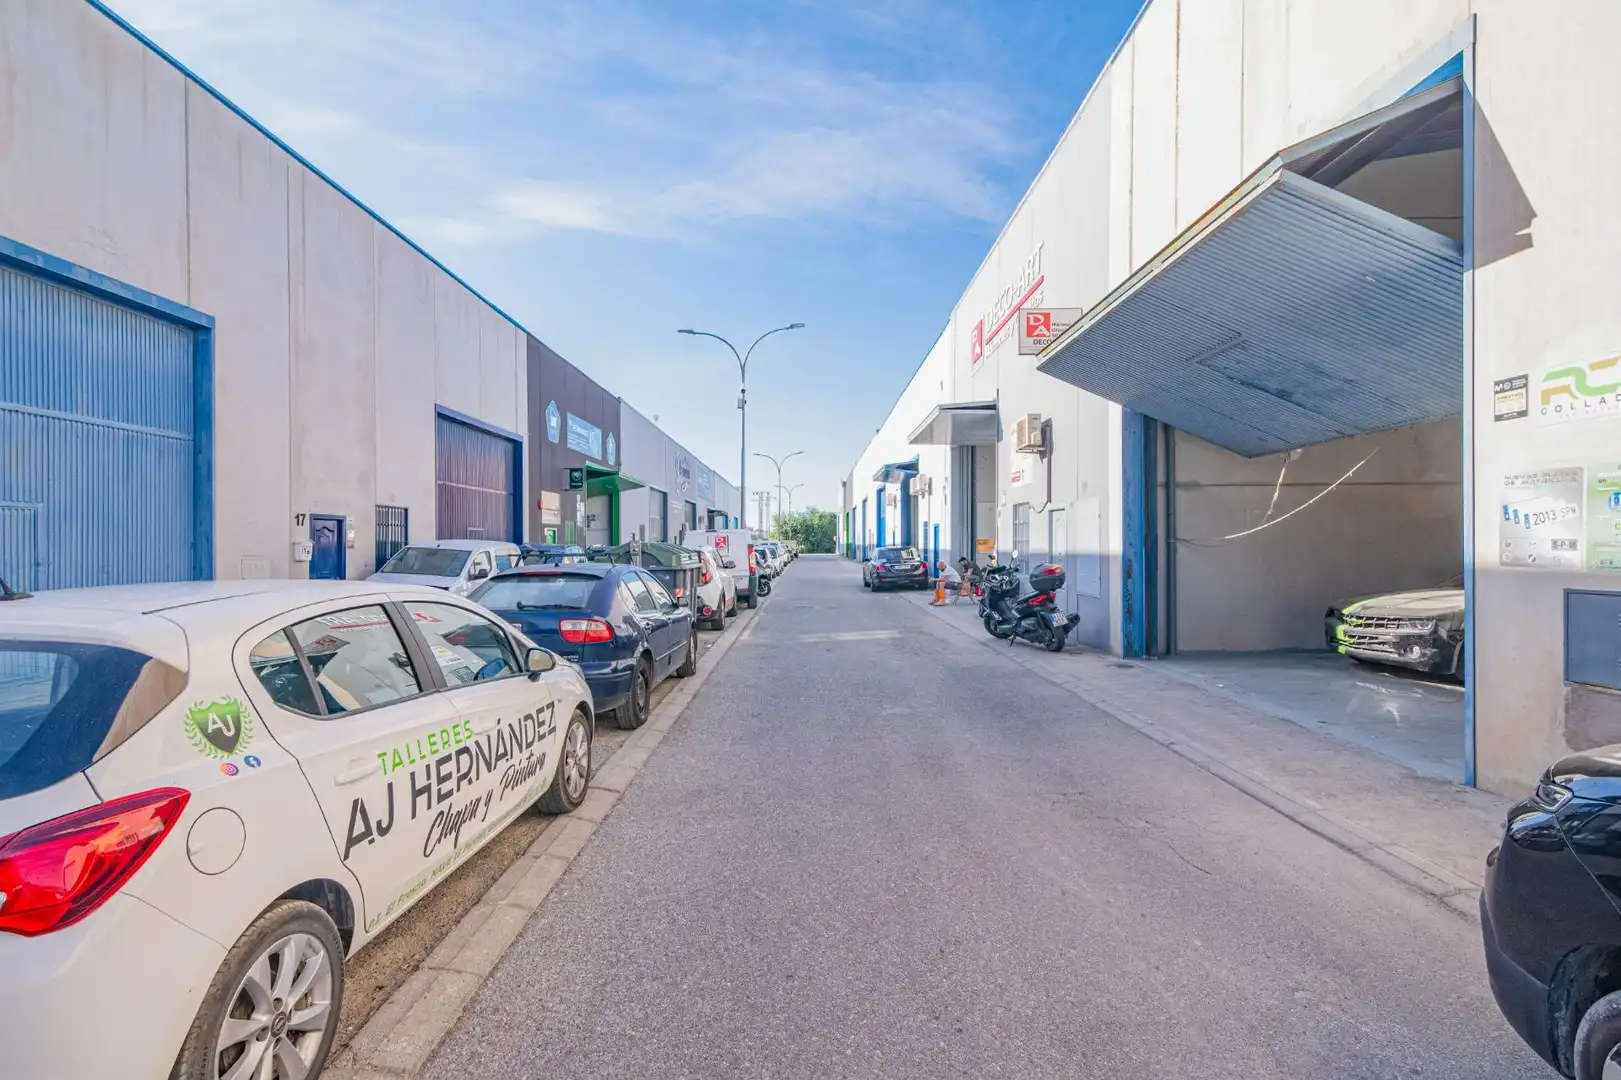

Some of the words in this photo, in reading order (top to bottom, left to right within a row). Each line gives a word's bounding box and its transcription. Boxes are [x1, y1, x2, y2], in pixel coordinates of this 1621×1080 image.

[983, 239, 1045, 334] DECO-ART
[294, 513, 306, 527] 17
[1532, 509, 1558, 526] 2013
[1560, 505, 1577, 519] SPM
[207, 711, 236, 737] AJ
[377, 720, 474, 776] TALLERES
[343, 781, 395, 862] AJ
[410, 700, 557, 820] HERNÁNDEZ
[423, 796, 482, 858] Chapa
[481, 788, 494, 822] y
[500, 749, 547, 801] Pintura
